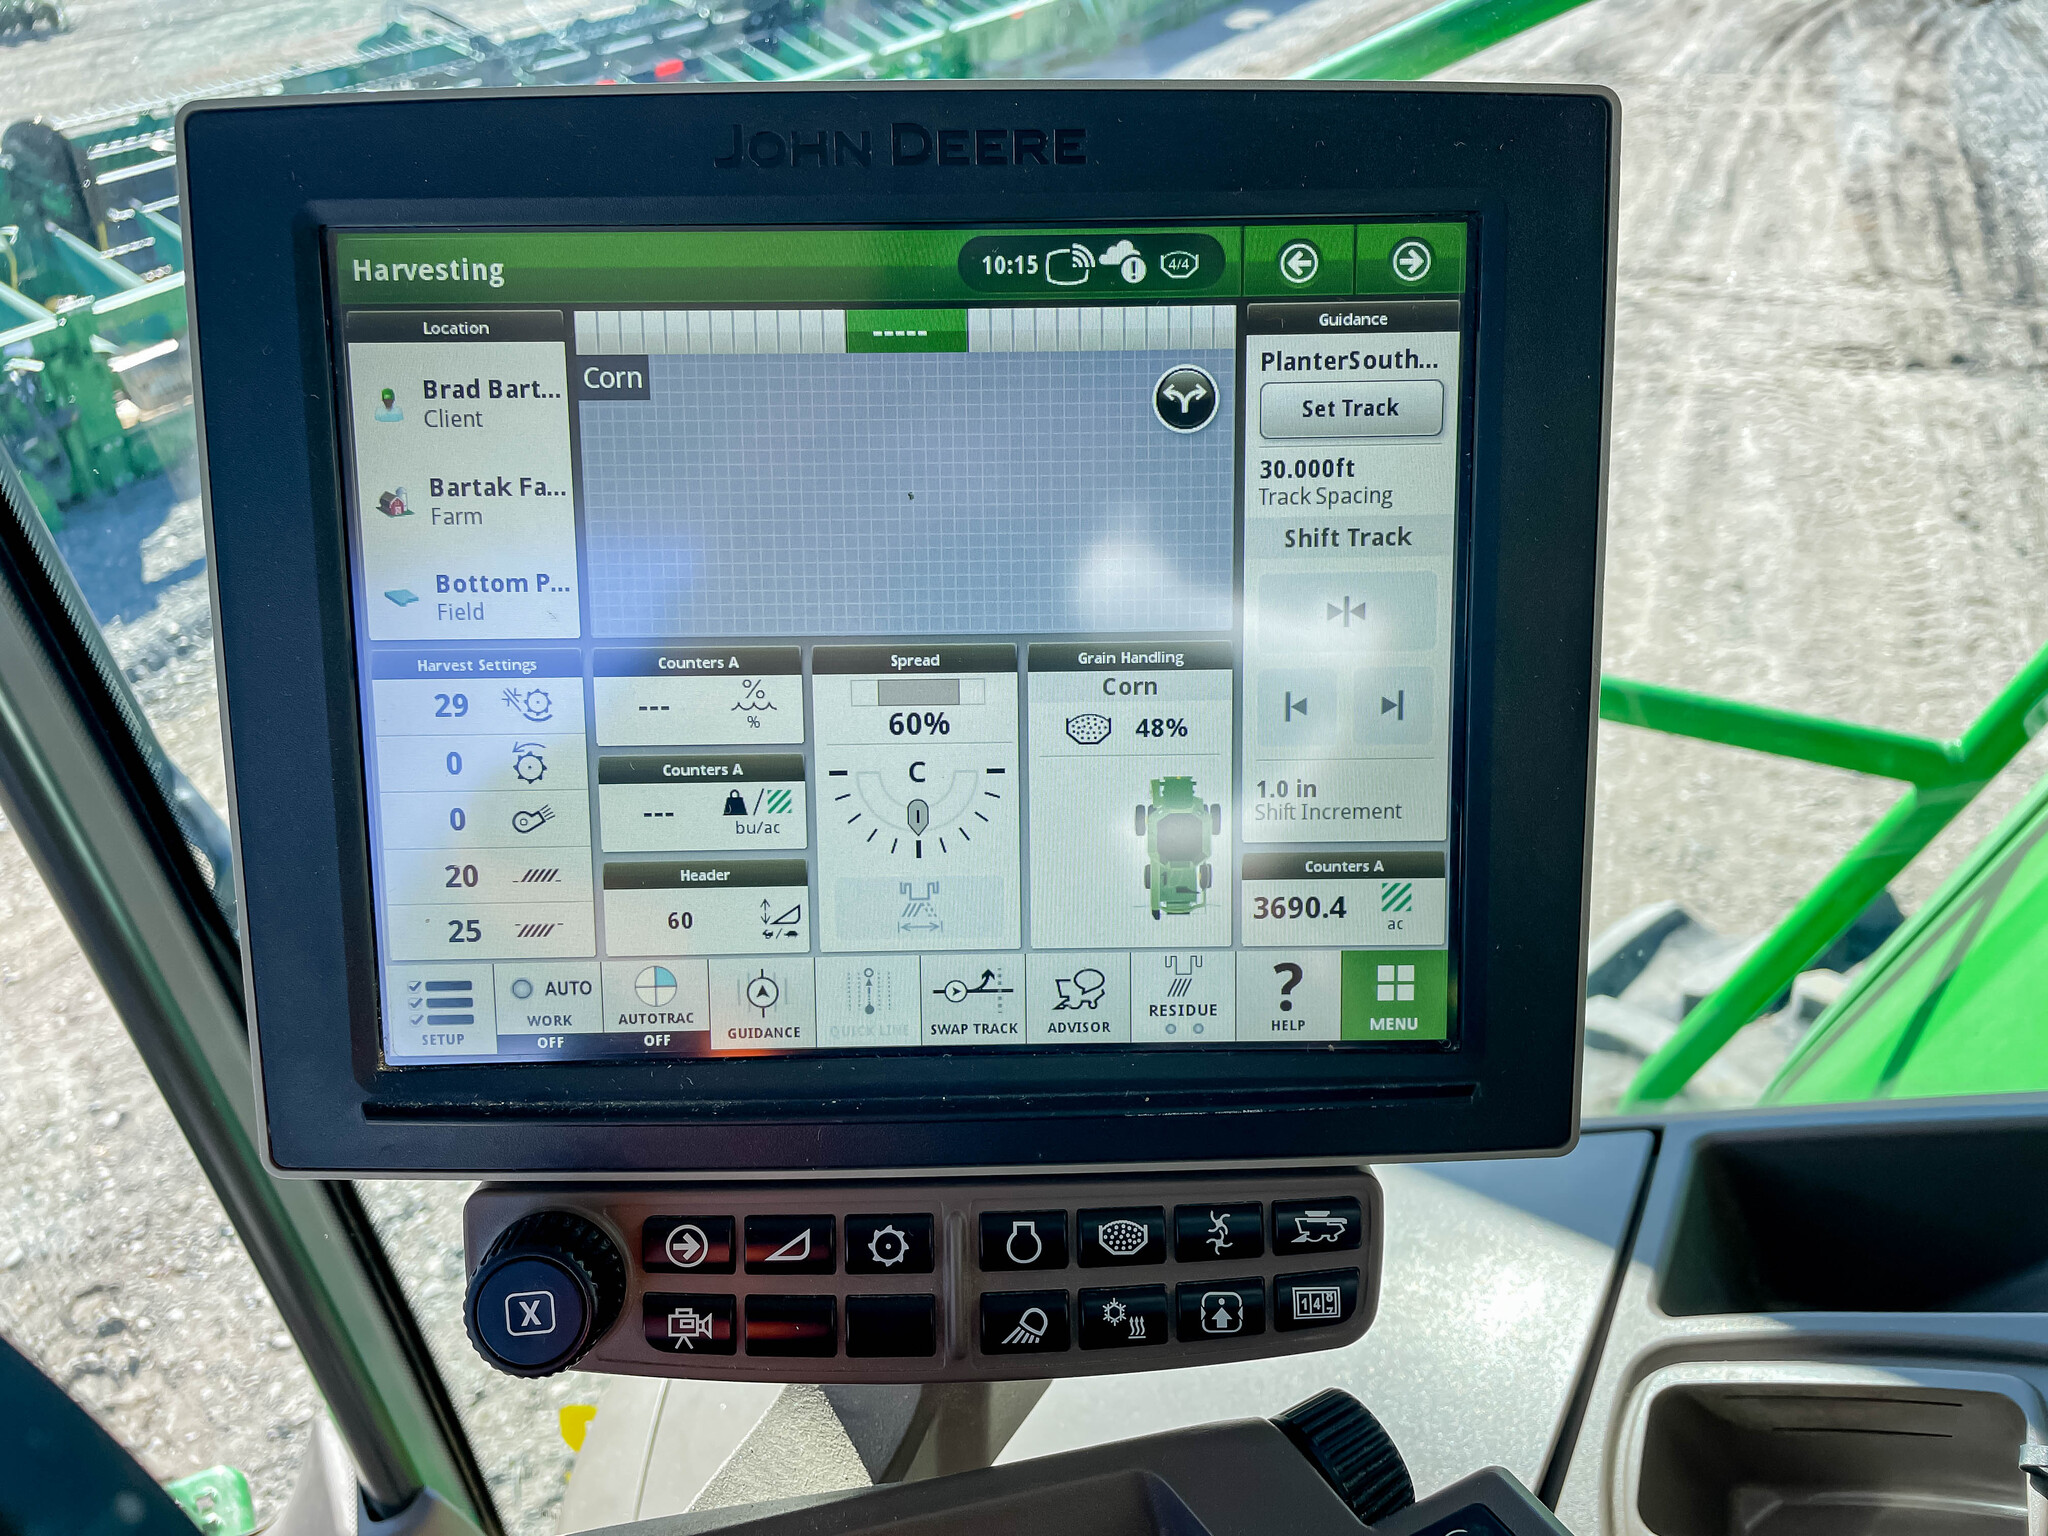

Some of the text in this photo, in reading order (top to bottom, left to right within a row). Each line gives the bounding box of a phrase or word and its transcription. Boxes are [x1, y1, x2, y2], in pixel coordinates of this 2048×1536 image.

[713, 122, 1088, 169] JOHN DEERE
[353, 257, 505, 287] Harvesting
[982, 255, 1038, 275] 10:15
[1168, 258, 1189, 270] 4/4
[422, 321, 490, 336] Location
[1318, 311, 1388, 328] Guidance
[1260, 349, 1439, 372] PlanterSouth...
[583, 366, 643, 390] Corn
[423, 378, 561, 400] Brad Bart...
[1301, 398, 1399, 418] Set Track
[424, 409, 483, 428] Client
[1259, 457, 1355, 479] 30.000ft
[429, 476, 567, 498] Bartak Fa...
[1259, 485, 1393, 509] Track Spacing
[431, 507, 483, 526] Farm
[1284, 527, 1412, 548] Shift Track
[436, 574, 529, 593] Bottom
[437, 602, 485, 621] Field
[417, 658, 537, 674] Harvest Settings
[658, 656, 740, 670] Counters A
[891, 654, 940, 668] Spread
[1078, 651, 1184, 667] Grain Handling
[1102, 677, 1158, 696] Corn
[434, 692, 469, 718] 29
[888, 712, 950, 736] 60%
[1135, 718, 1188, 738] 48%
[446, 752, 462, 775] 0
[662, 763, 744, 777] Counters A
[909, 762, 926, 782] C
[1256, 779, 1317, 798] 1.0 in
[449, 807, 465, 830] 0
[1255, 802, 1402, 821] Shift Increment
[735, 820, 780, 836] bu/ac
[444, 864, 479, 888] 20
[680, 868, 731, 882] Header
[1305, 860, 1384, 874] Counters A
[1253, 896, 1347, 920] 3690.4
[667, 911, 693, 929] 60
[1387, 918, 1403, 930] ac
[448, 919, 482, 943] 25
[544, 980, 592, 996] AUTO
[618, 1012, 694, 1025] AUTOTRAC
[1149, 1002, 1219, 1018] RESIDUE
[527, 1014, 572, 1028] WORK
[930, 1021, 1018, 1036] SWAP TRACK
[1047, 1020, 1111, 1035] ADVISOR
[1271, 1018, 1306, 1032] HELP
[1369, 1016, 1419, 1032] MENU
[422, 1033, 465, 1046] SETUP
[644, 1034, 671, 1047] OFF
[727, 1026, 801, 1039] GUIDANCE
[537, 1036, 565, 1049] OFF
[519, 1300, 541, 1326] X
